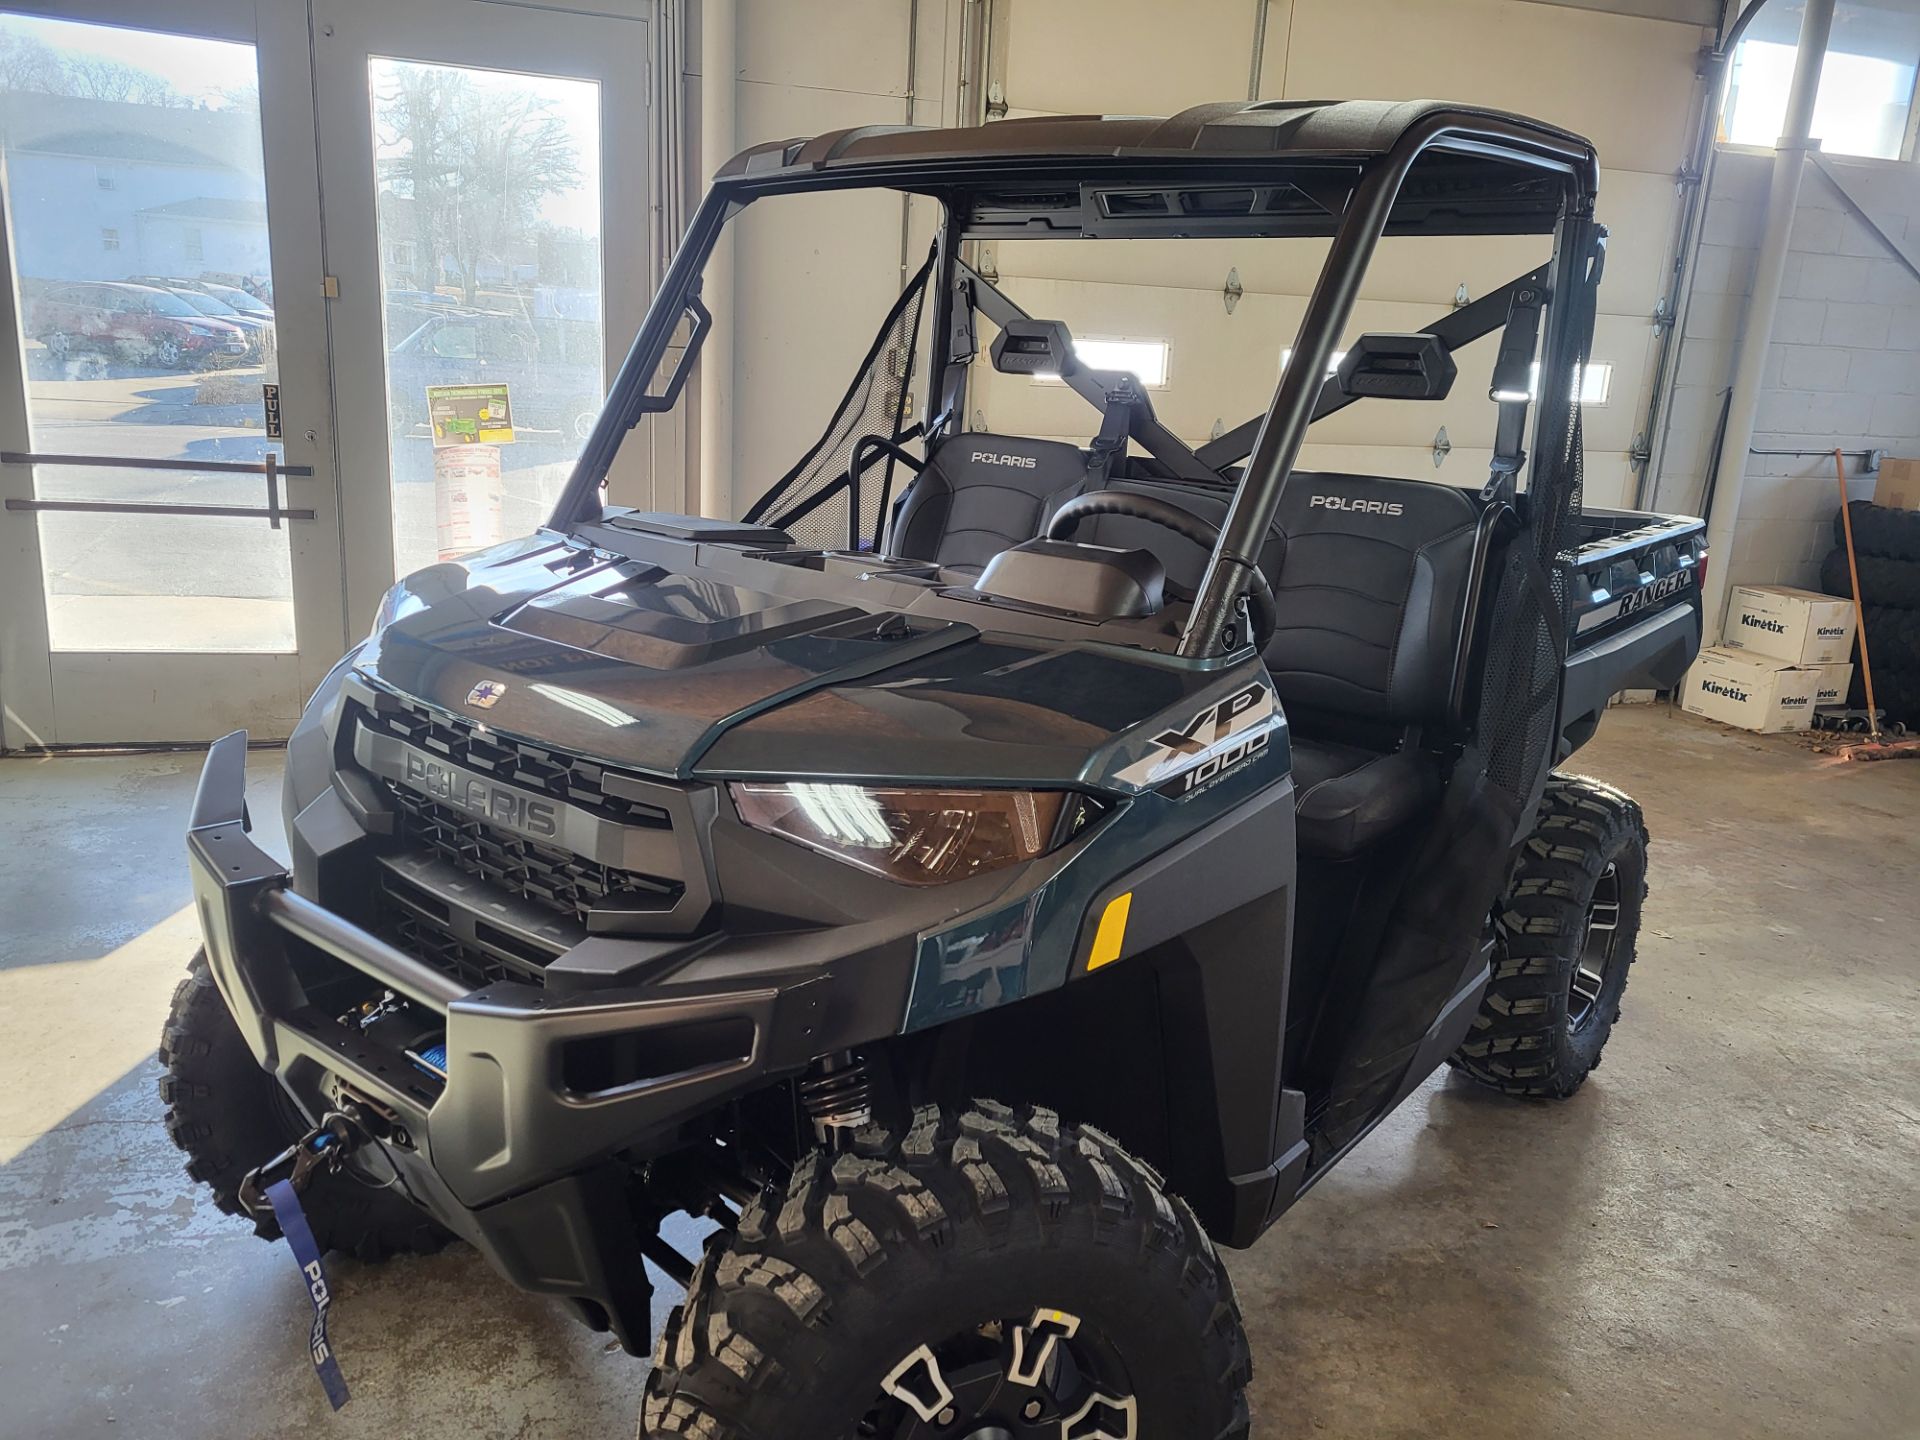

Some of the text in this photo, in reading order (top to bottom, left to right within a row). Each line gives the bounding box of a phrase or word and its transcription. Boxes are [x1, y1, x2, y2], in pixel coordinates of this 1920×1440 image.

[266, 386, 280, 436] PULL
[971, 452, 1036, 469] POLARIS
[1310, 495, 1403, 516] POLARIS
[1617, 568, 1687, 619] RANGER
[1741, 613, 1784, 634] Kinetix
[1817, 627, 1844, 636] Kinetix
[1702, 680, 1747, 702] Kinetix
[1781, 696, 1808, 705] Kinetix
[1817, 688, 1838, 698] inetix
[1150, 682, 1267, 764] XP
[1185, 729, 1271, 791] 1000
[407, 752, 555, 838] POLARIS
[1184, 786, 1207, 803] DUAL
[1208, 759, 1252, 788] OVERHEAD
[304, 1260, 330, 1365] POLARIS
